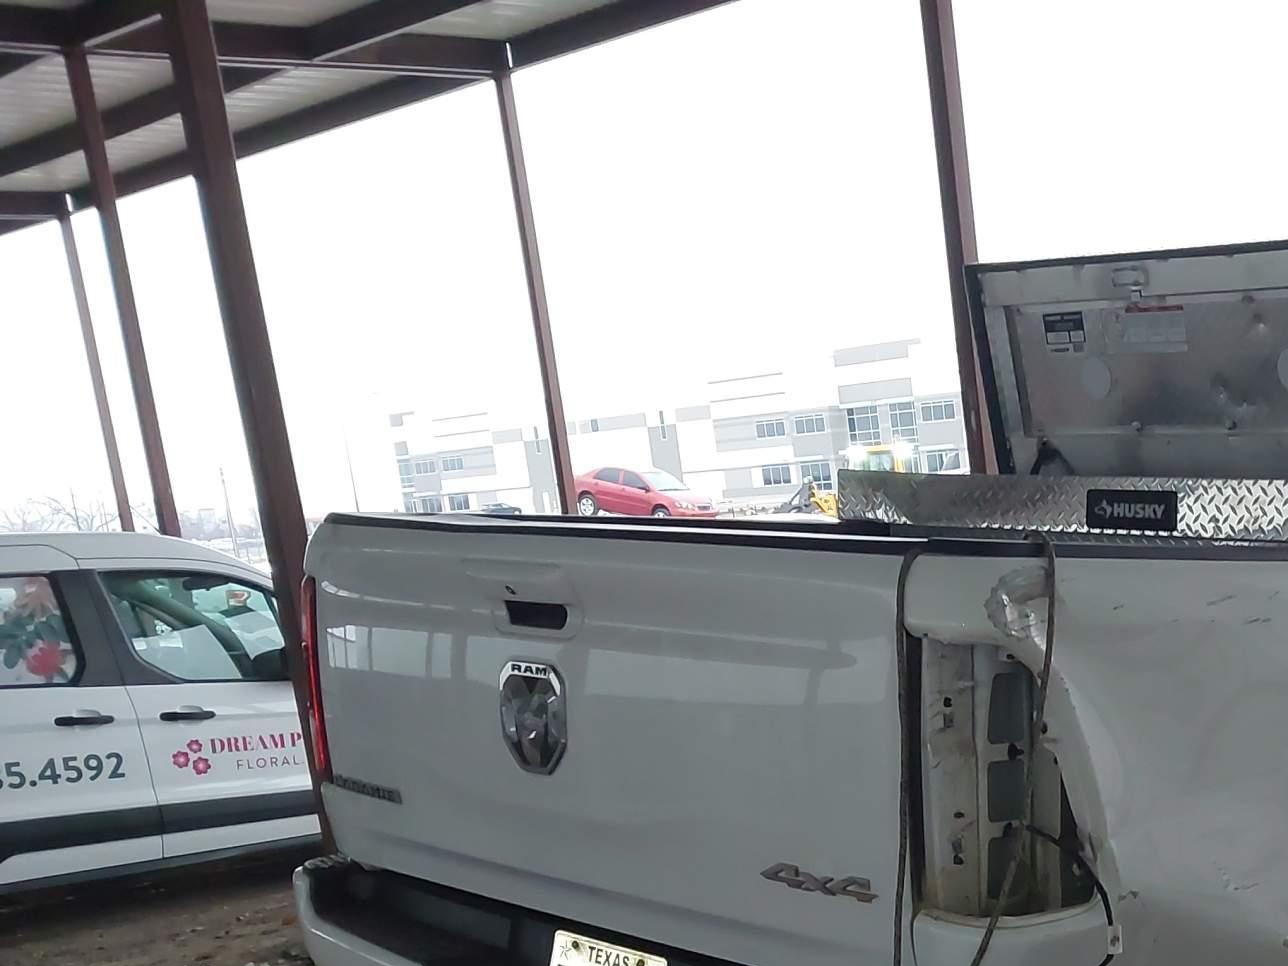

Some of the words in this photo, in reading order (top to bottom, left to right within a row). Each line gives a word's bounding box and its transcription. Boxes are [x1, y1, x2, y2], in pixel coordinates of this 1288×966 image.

[1113, 502, 1166, 519] HUSKY
[510, 663, 547, 677] RAM
[210, 733, 286, 754] DREAM
[0, 752, 126, 789] 5.4592
